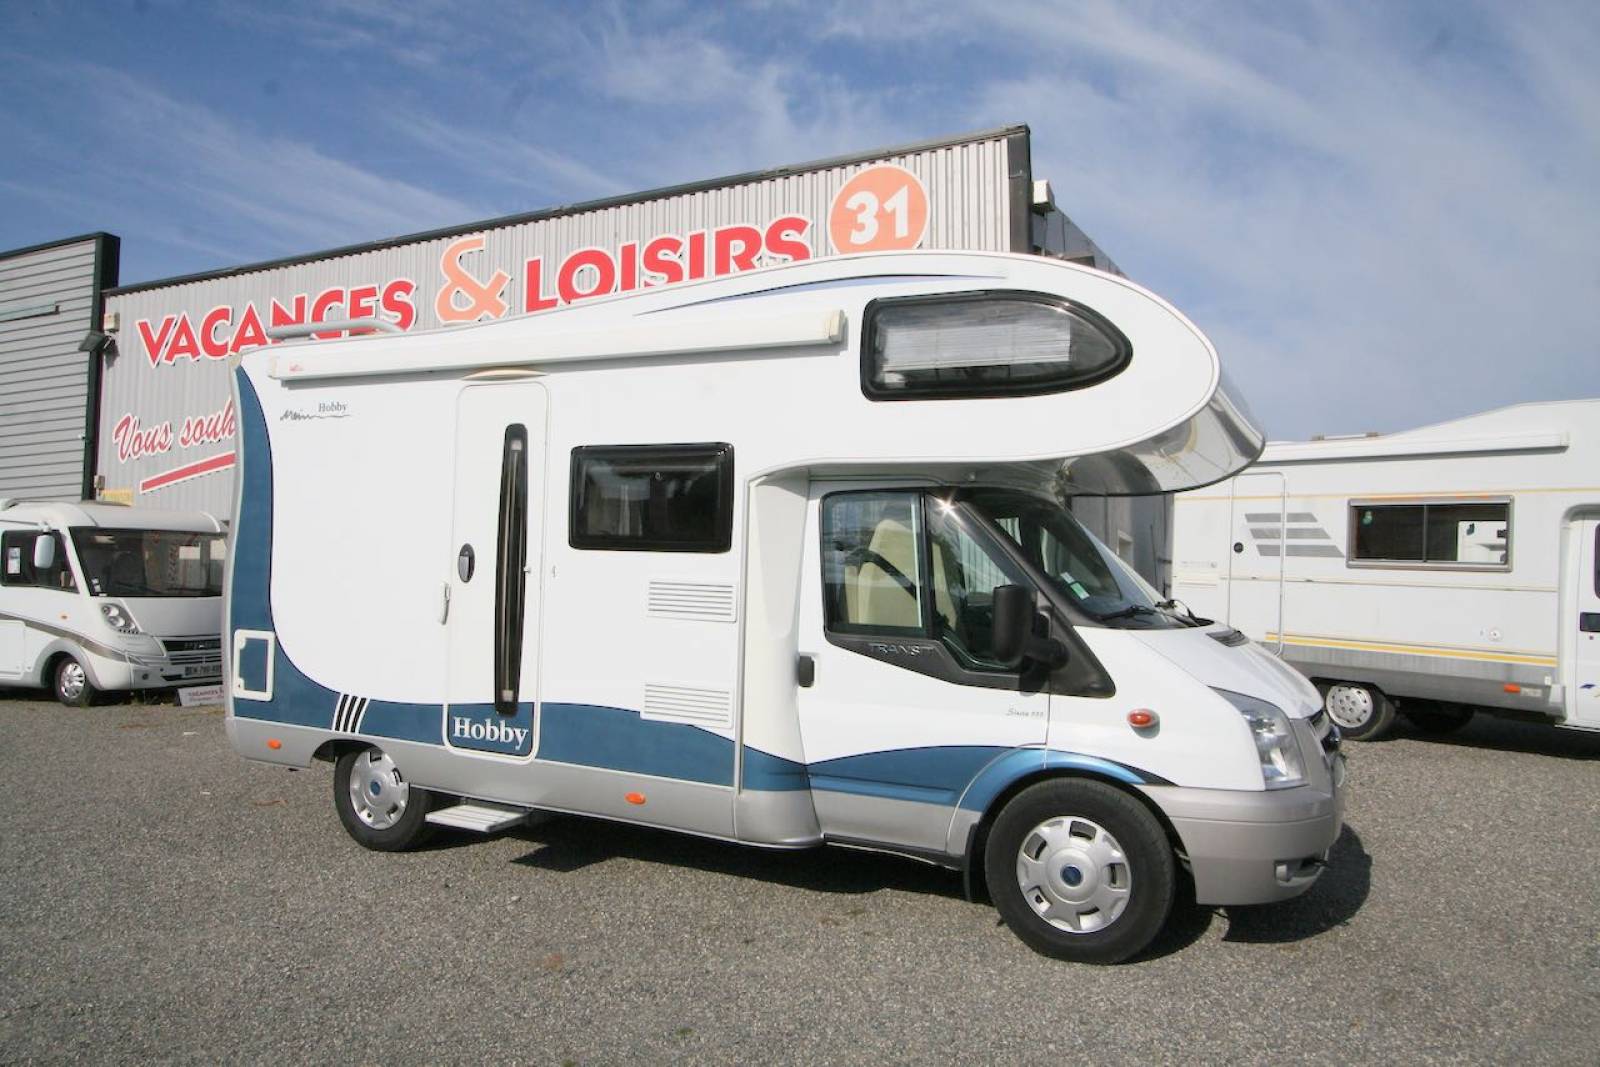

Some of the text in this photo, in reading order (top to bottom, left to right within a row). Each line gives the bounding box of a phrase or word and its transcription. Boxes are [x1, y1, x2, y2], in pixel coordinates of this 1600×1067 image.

[136, 184, 910, 366] VACANCES & LOISIRS 31
[319, 401, 349, 413] Hobby
[113, 413, 173, 463] Vous
[453, 716, 528, 750] Hobby
